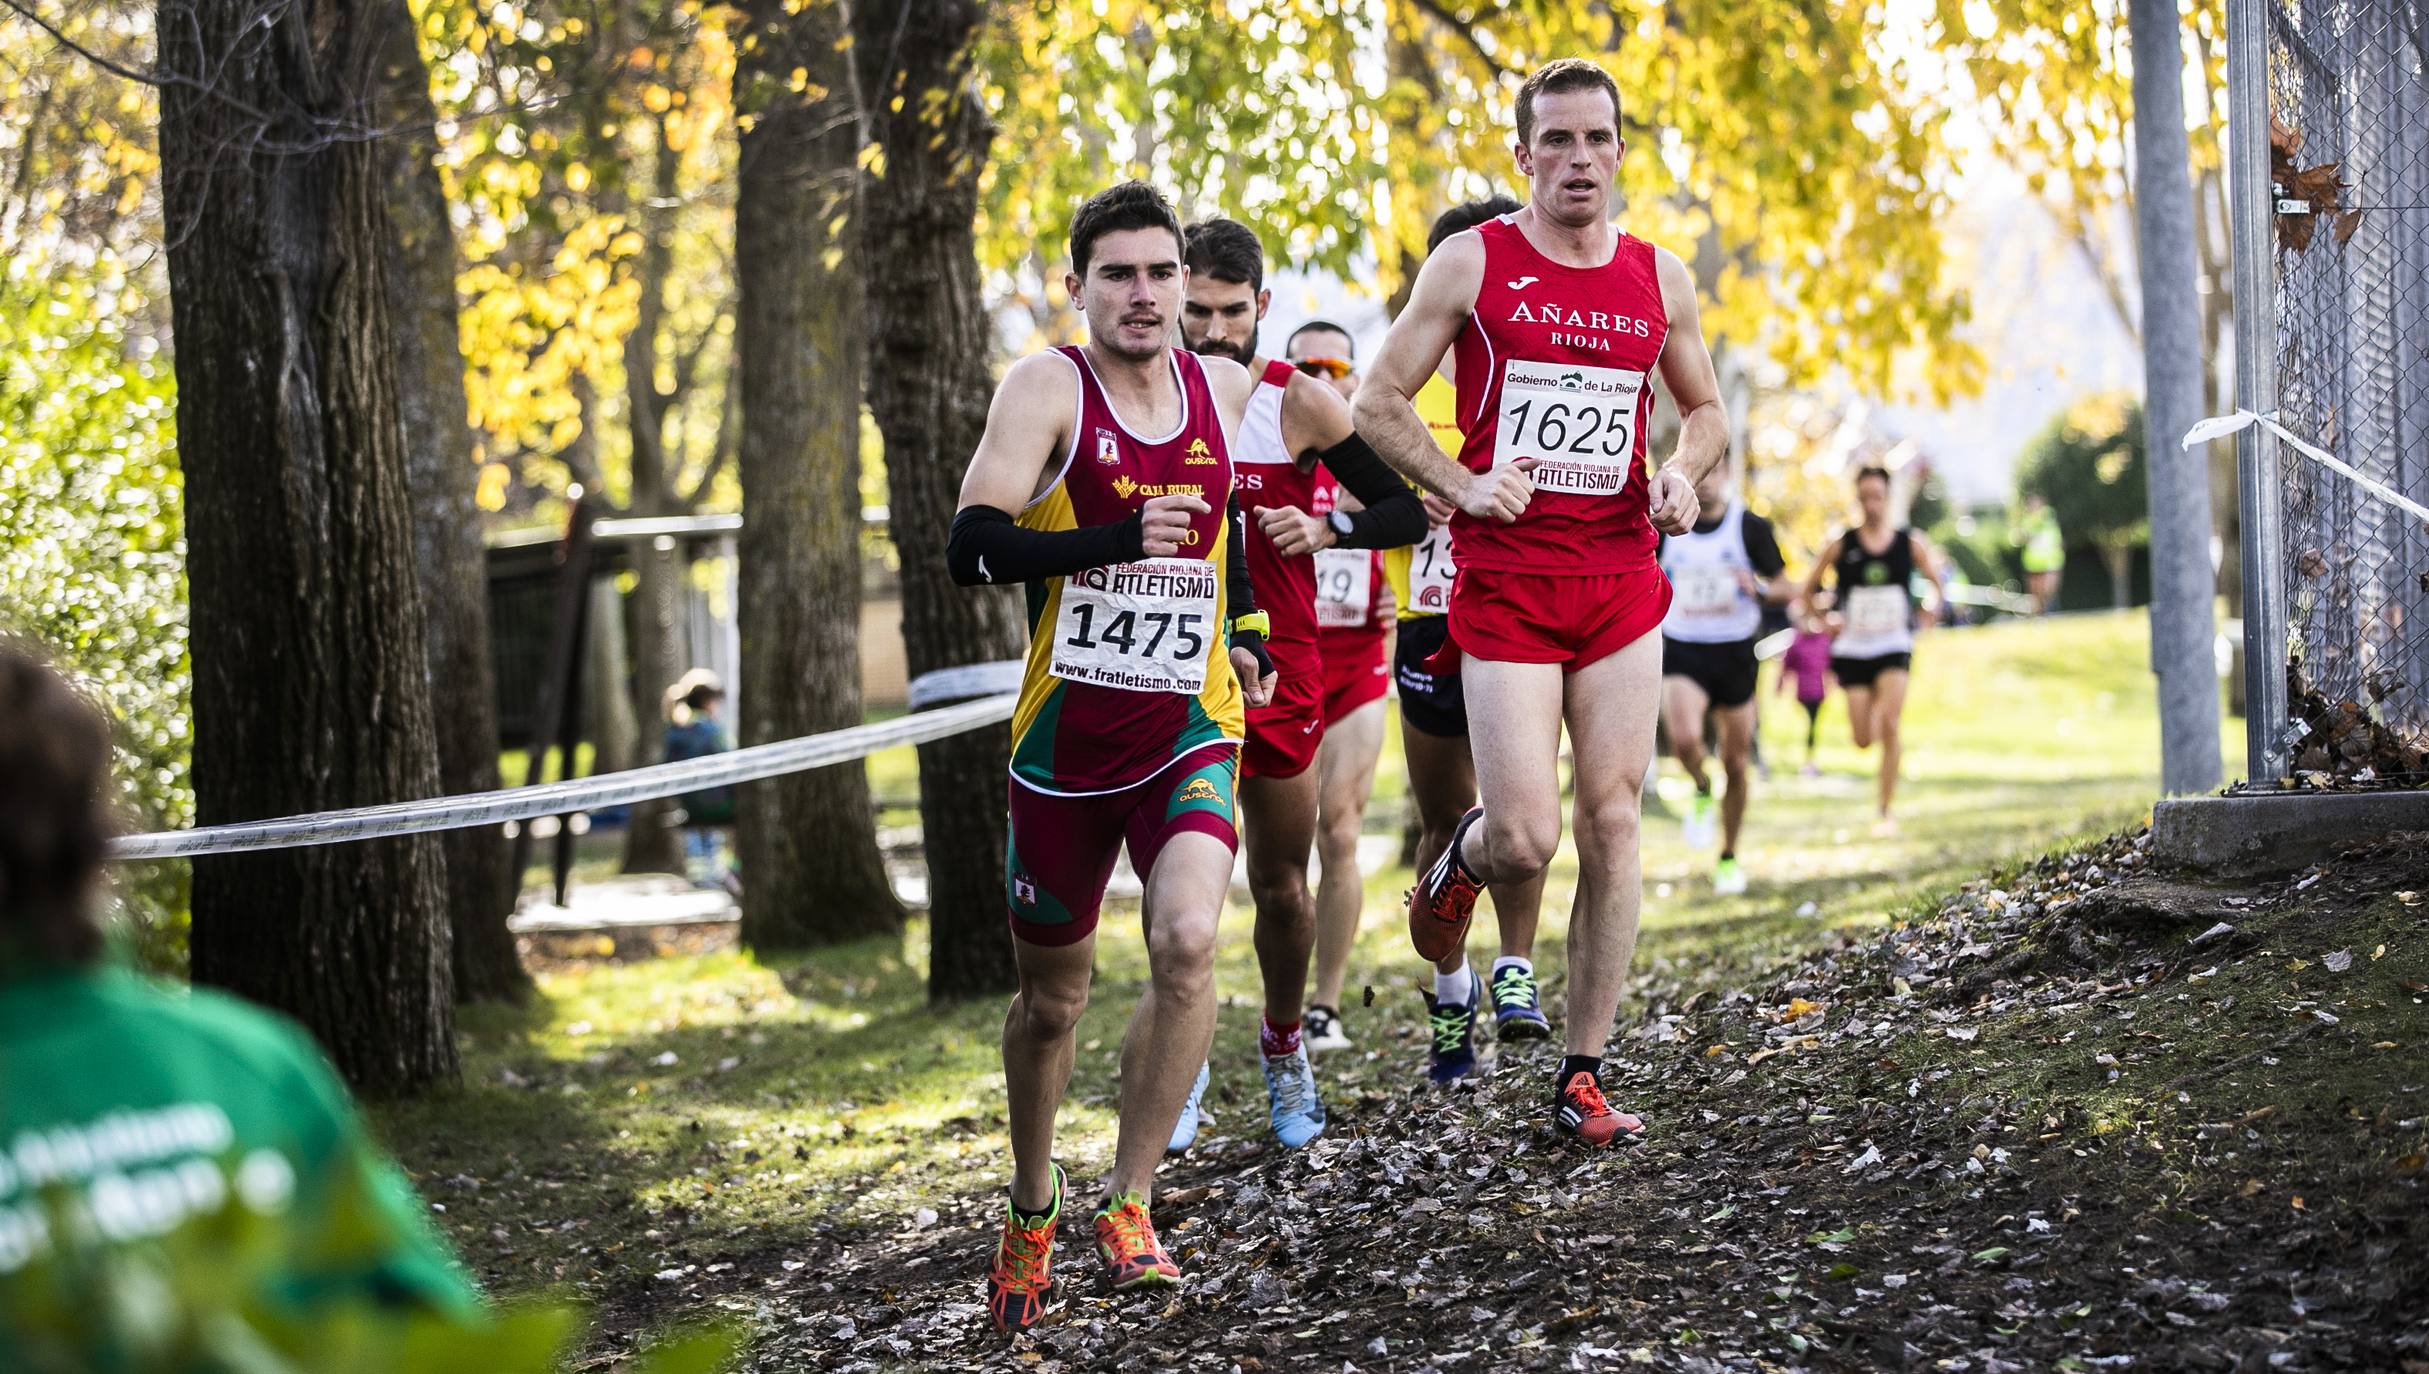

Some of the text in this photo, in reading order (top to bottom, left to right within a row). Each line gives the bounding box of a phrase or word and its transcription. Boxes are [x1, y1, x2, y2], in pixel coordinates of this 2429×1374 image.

[1508, 301, 1649, 337] AÑARES
[1551, 332, 1611, 351] RIOJA
[1507, 373, 1638, 395] Gobierno de La Rioja
[1508, 400, 1630, 456] 1625
[1540, 460, 1581, 471] FEDERACIÓN
[1583, 464, 1611, 473] RIOJANA
[1166, 484, 1205, 496] RURAL
[1538, 469, 1620, 490] ATLETISMO
[1116, 562, 1214, 577] FEDERACIÓN RIOJANA DE
[1112, 574, 1214, 598] ATLETISMO
[1067, 603, 1203, 660] 1475
[1055, 661, 1201, 690] www.fratletismo.com
